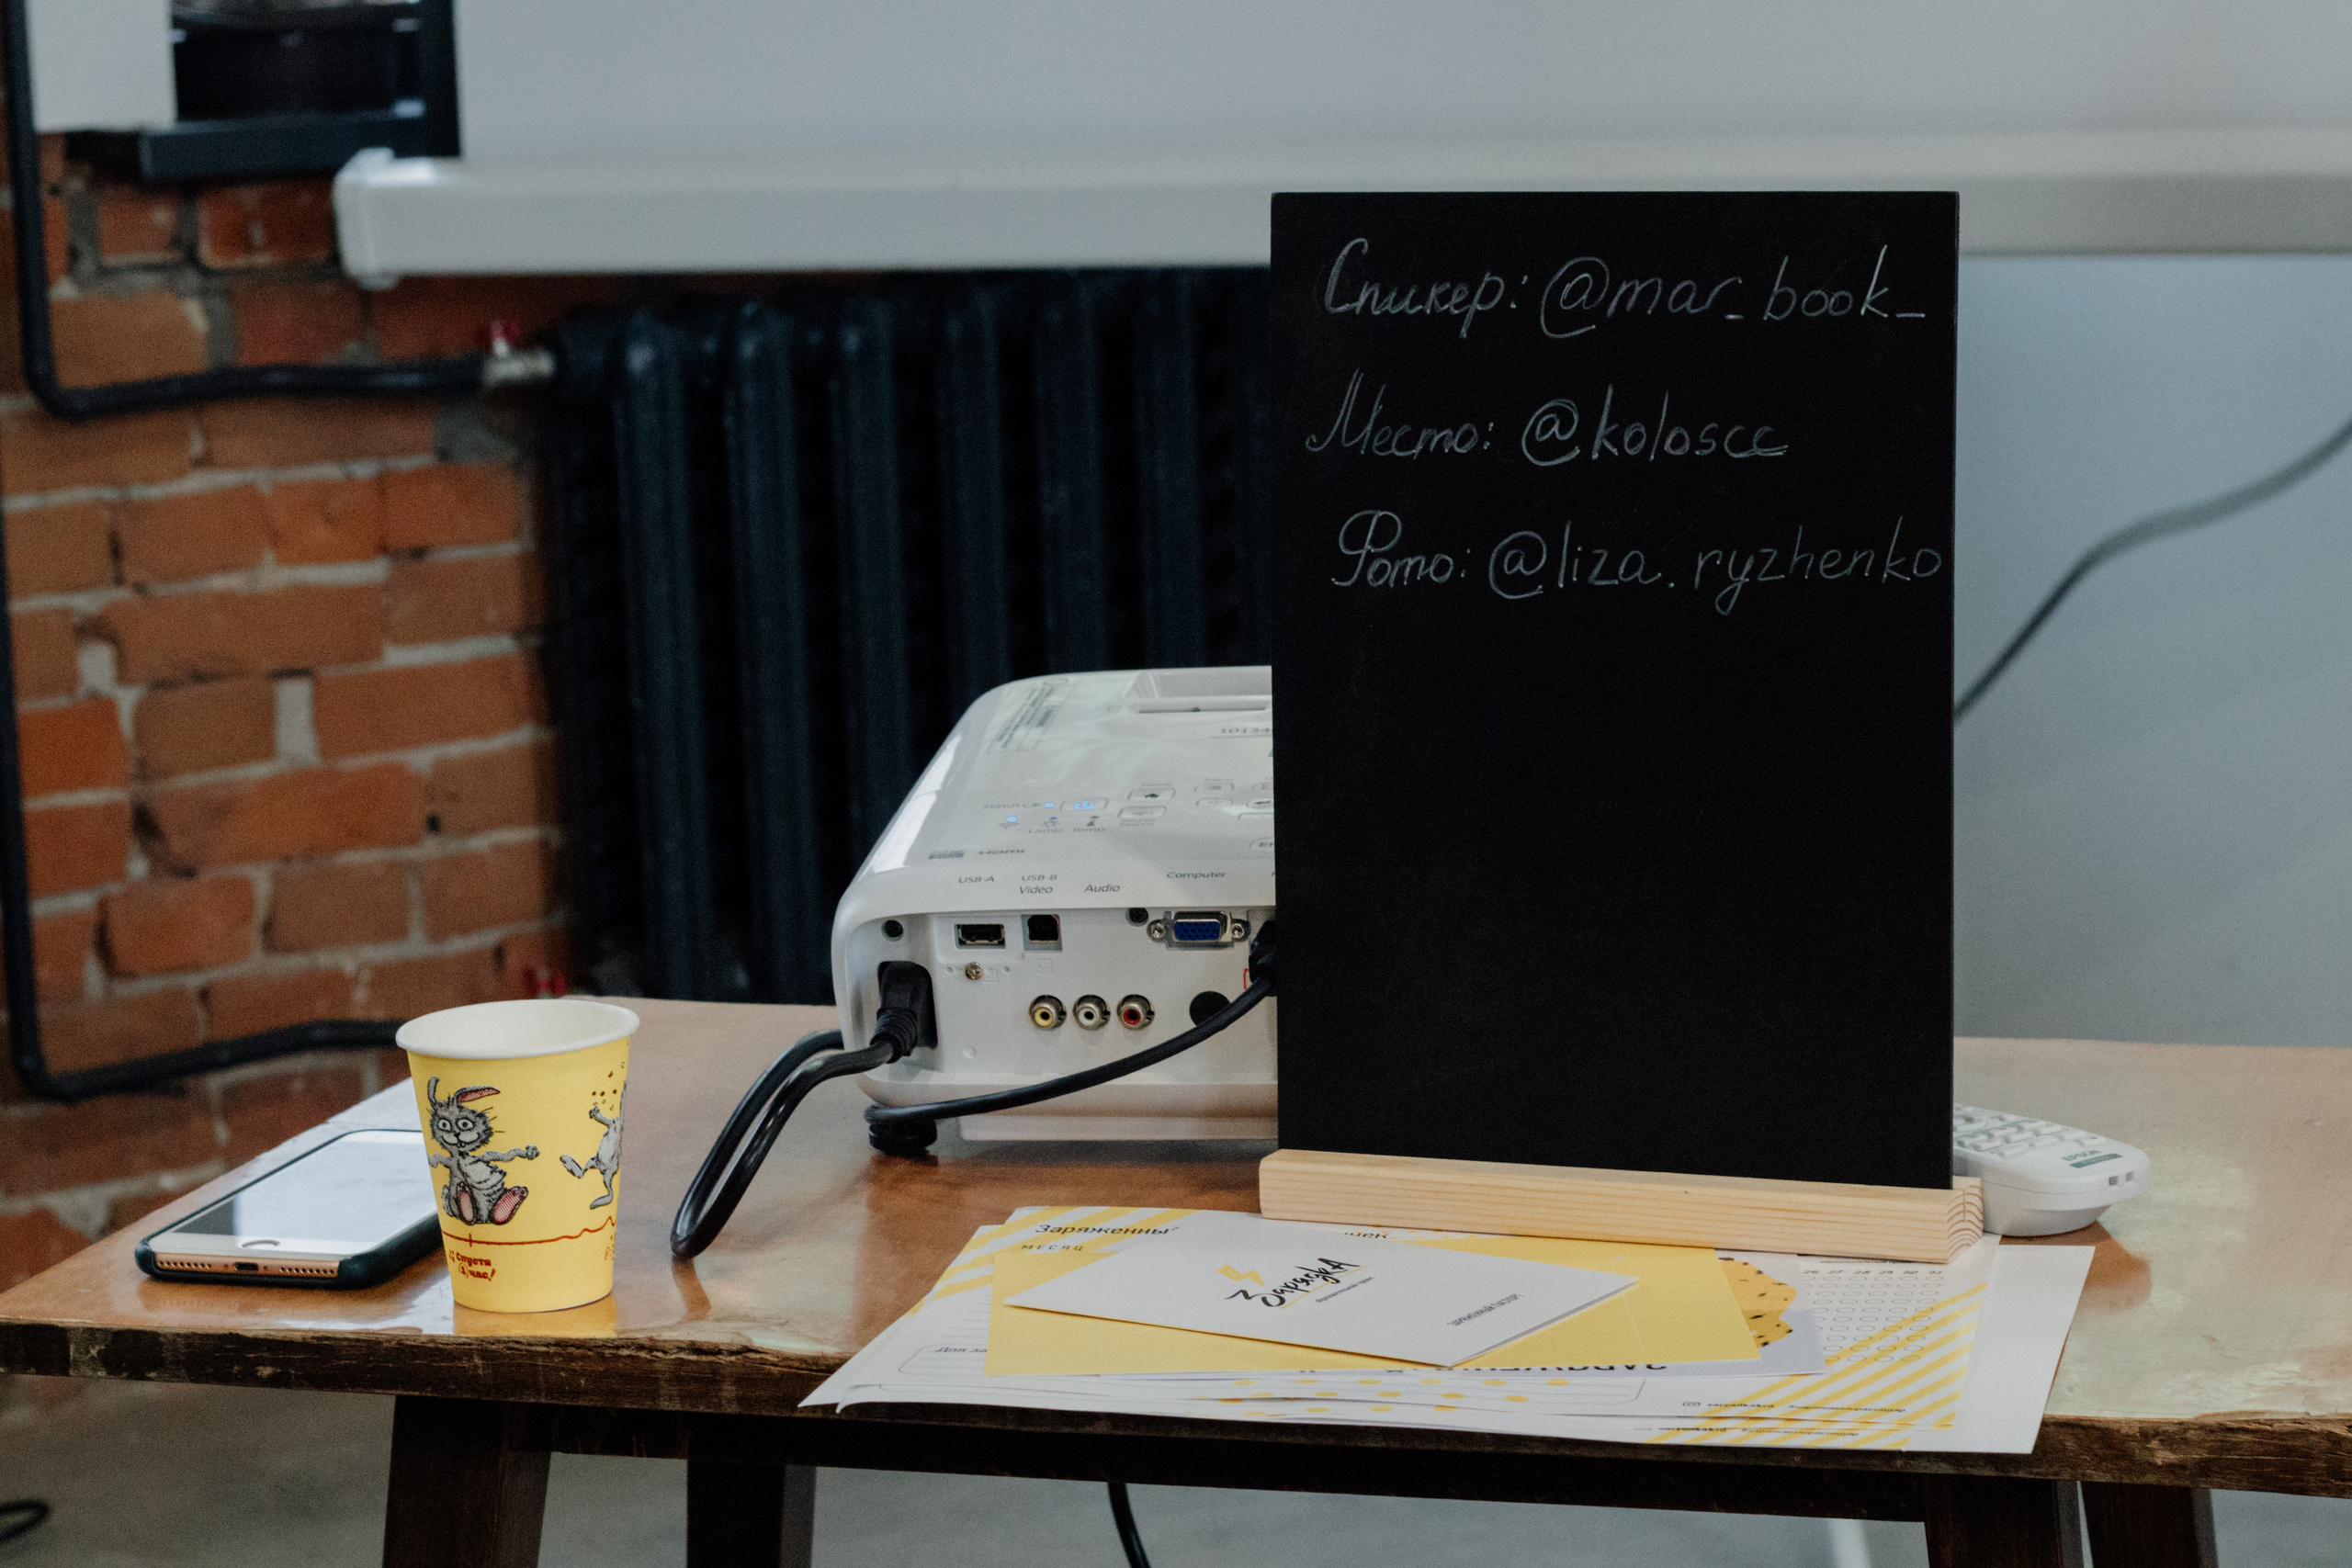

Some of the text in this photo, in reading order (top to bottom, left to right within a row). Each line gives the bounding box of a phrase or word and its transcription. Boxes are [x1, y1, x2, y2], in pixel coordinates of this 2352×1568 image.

[1325, 238, 1528, 338] Спикер:
[1306, 368, 1493, 457] Место:
[1331, 509, 1470, 587] Фото:
[957, 875, 995, 884] USB-A
[1166, 871, 1227, 879] Computer
[1019, 886, 1054, 895] Video
[1083, 884, 1121, 893] Audio
[1035, 1224, 1180, 1235] Заряженны
